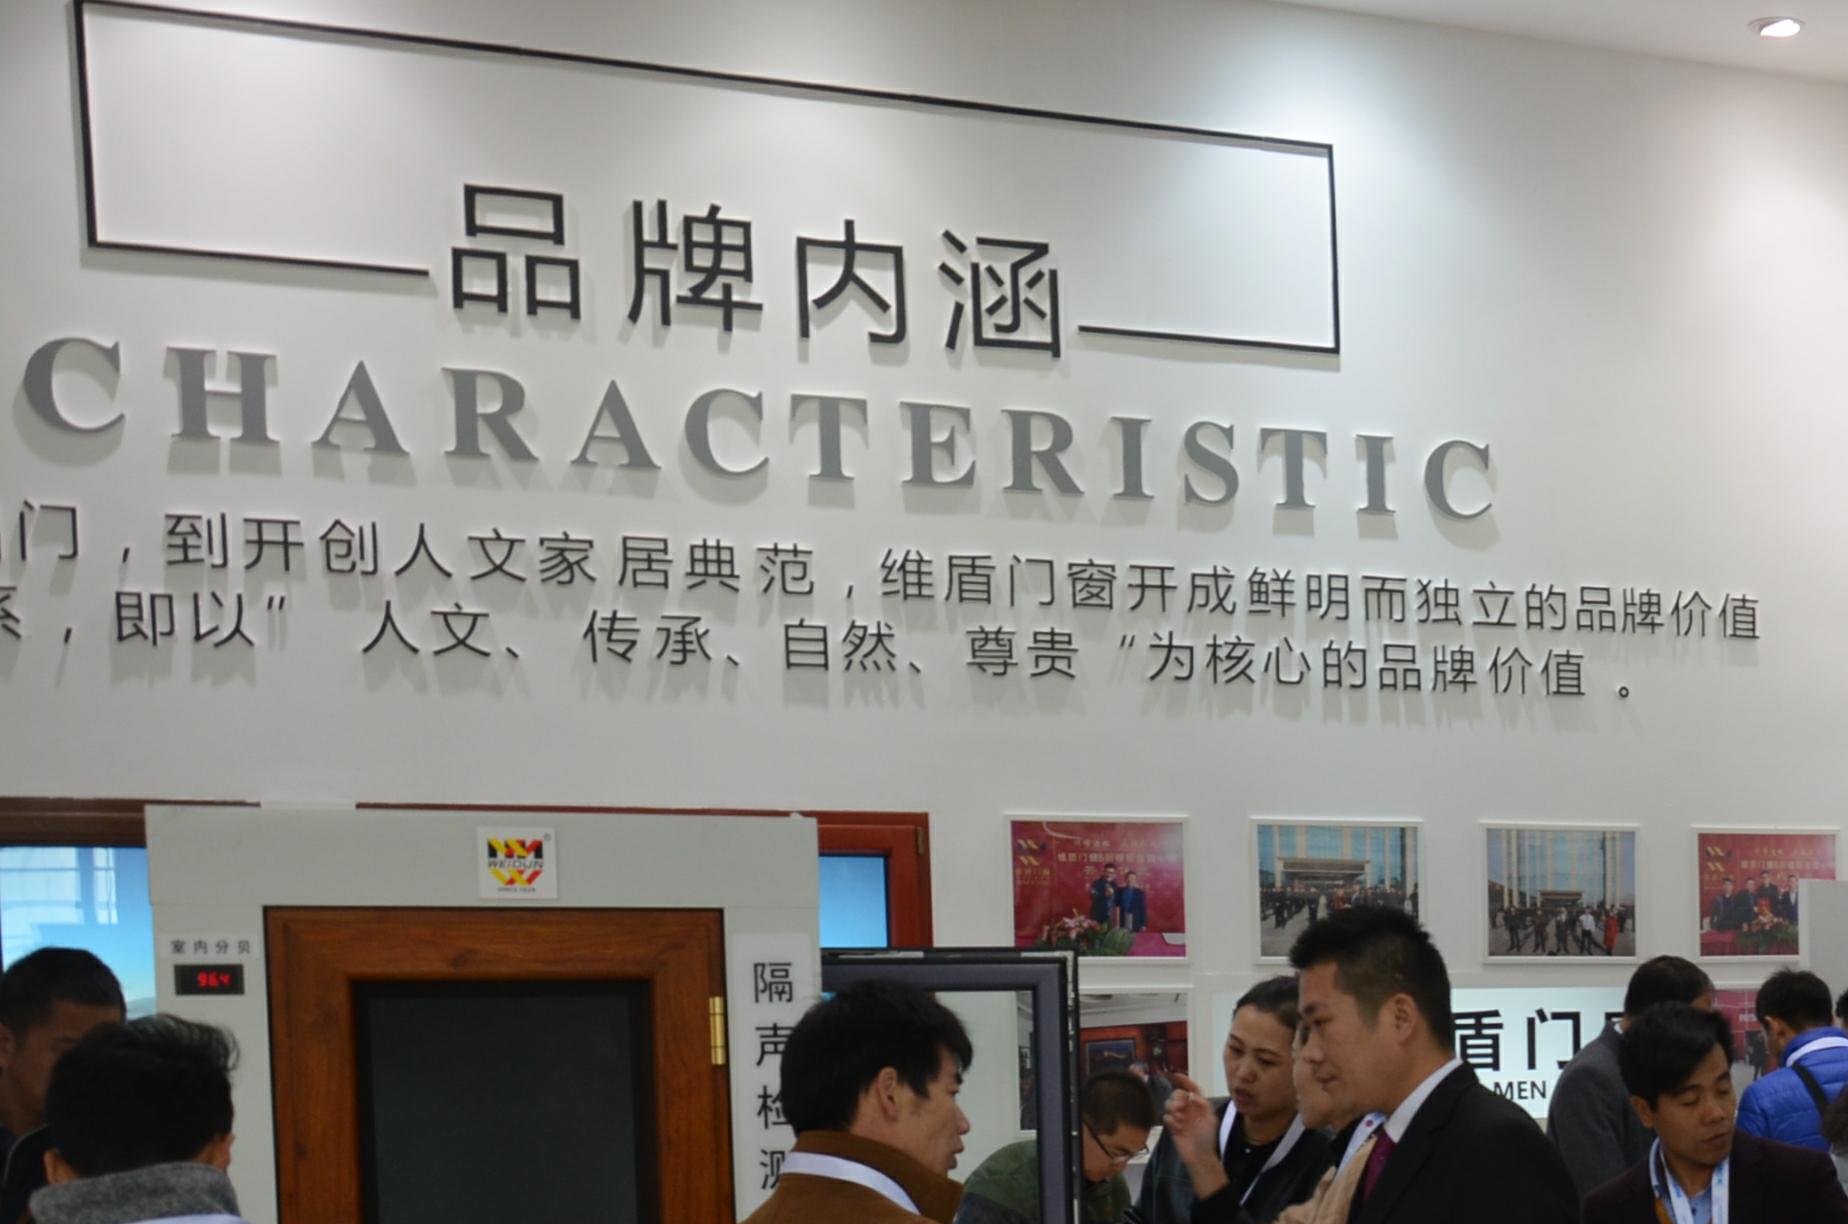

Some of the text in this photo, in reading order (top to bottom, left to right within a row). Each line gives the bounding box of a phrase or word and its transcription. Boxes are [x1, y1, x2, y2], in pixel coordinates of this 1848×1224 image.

[451, 183, 1063, 358] 品牌内涵
[23, 337, 1494, 520] CHARACTERISTIC
[171, 938, 251, 956] 室内分贝
